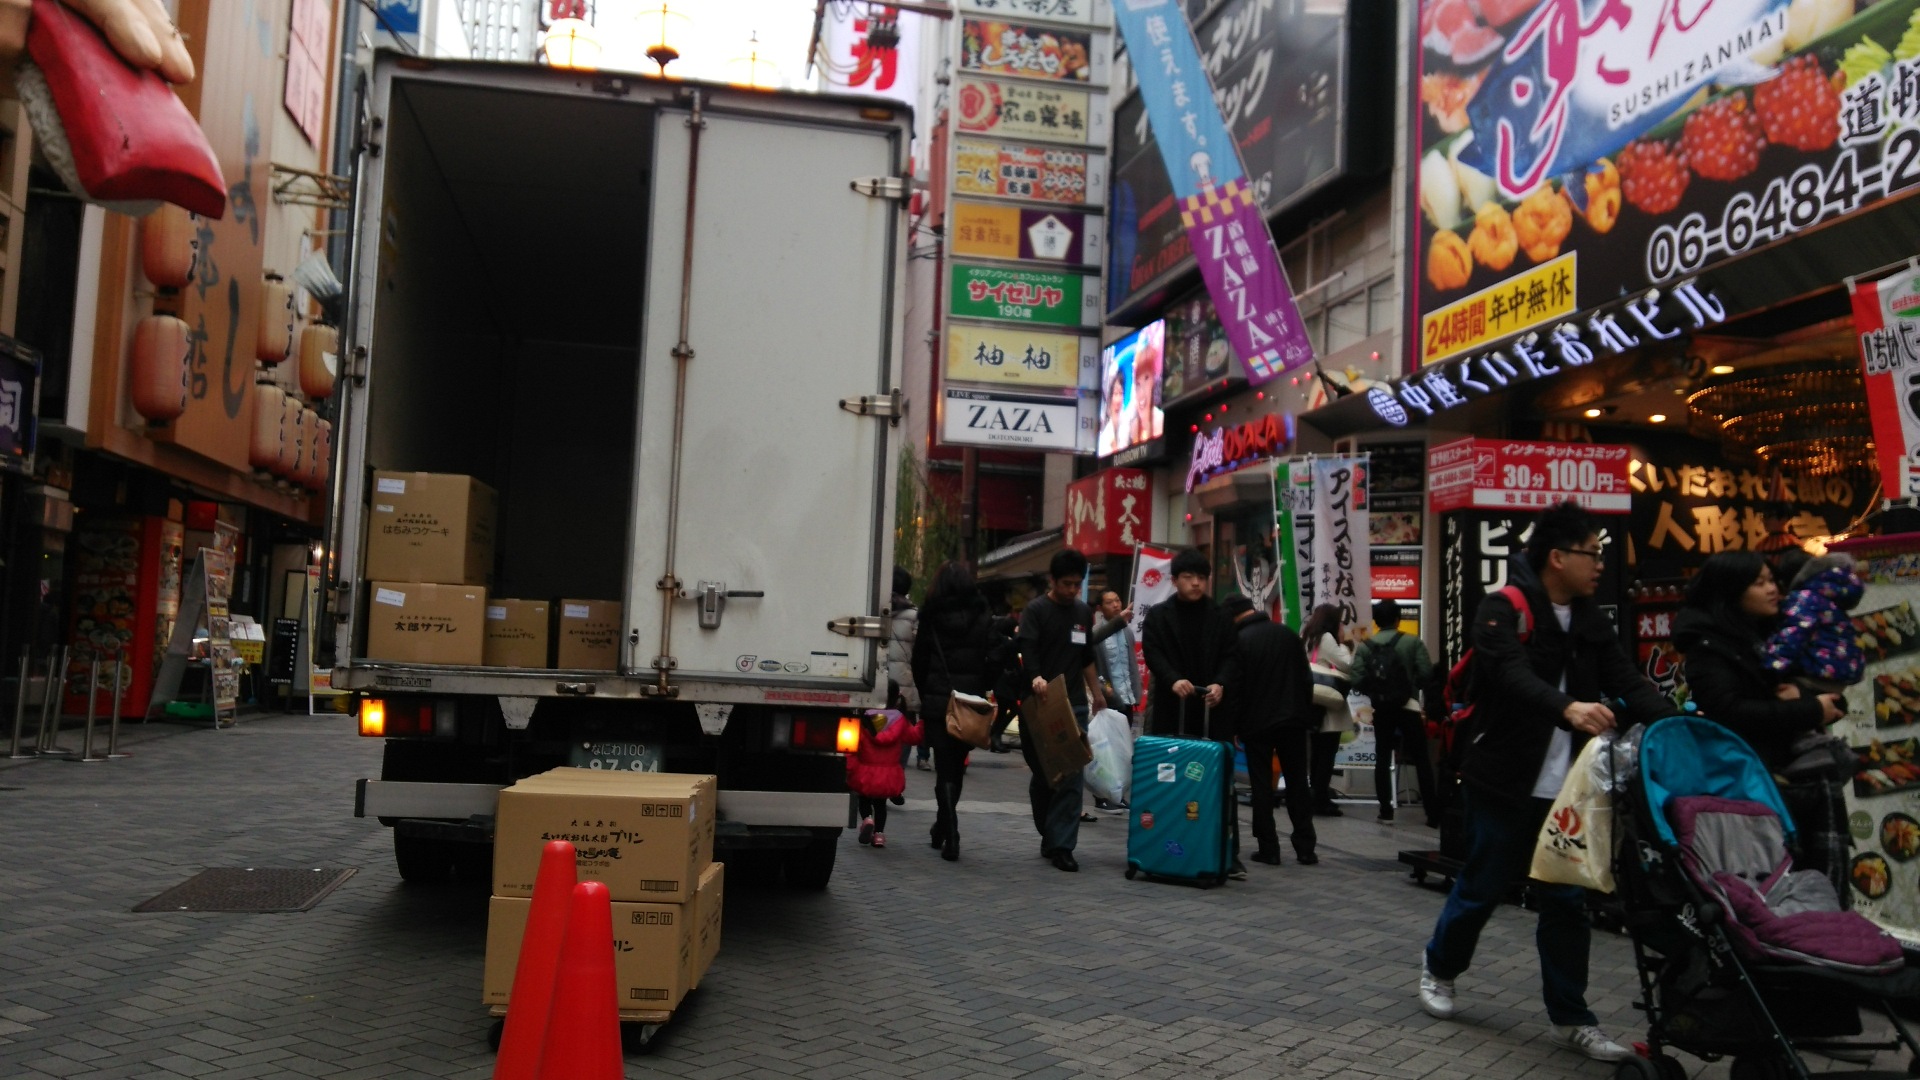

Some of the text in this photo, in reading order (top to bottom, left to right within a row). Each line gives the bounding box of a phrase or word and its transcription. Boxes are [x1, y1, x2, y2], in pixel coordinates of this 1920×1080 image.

[1610, 12, 1786, 124] SUSHIZANMAI
[967, 279, 1063, 308] サイゼリヤ
[1204, 225, 1274, 349] ZAZA
[1086, 294, 1098, 308] B1
[1488, 267, 1571, 329] 年中無休
[1425, 299, 1486, 356] 24時間
[1083, 355, 1096, 369] B1
[951, 391, 970, 400] LIVE
[968, 404, 1053, 433] ZAZA
[1081, 416, 1094, 429] B1
[988, 433, 1033, 443] DOTONBORI
[1223, 413, 1284, 462] OSAKA
[383, 525, 449, 537] はちみつケーキ
[1329, 467, 1358, 627] アイスもなか
[394, 621, 457, 633] 太郎サブレ
[591, 743, 645, 756] なにわ 100
